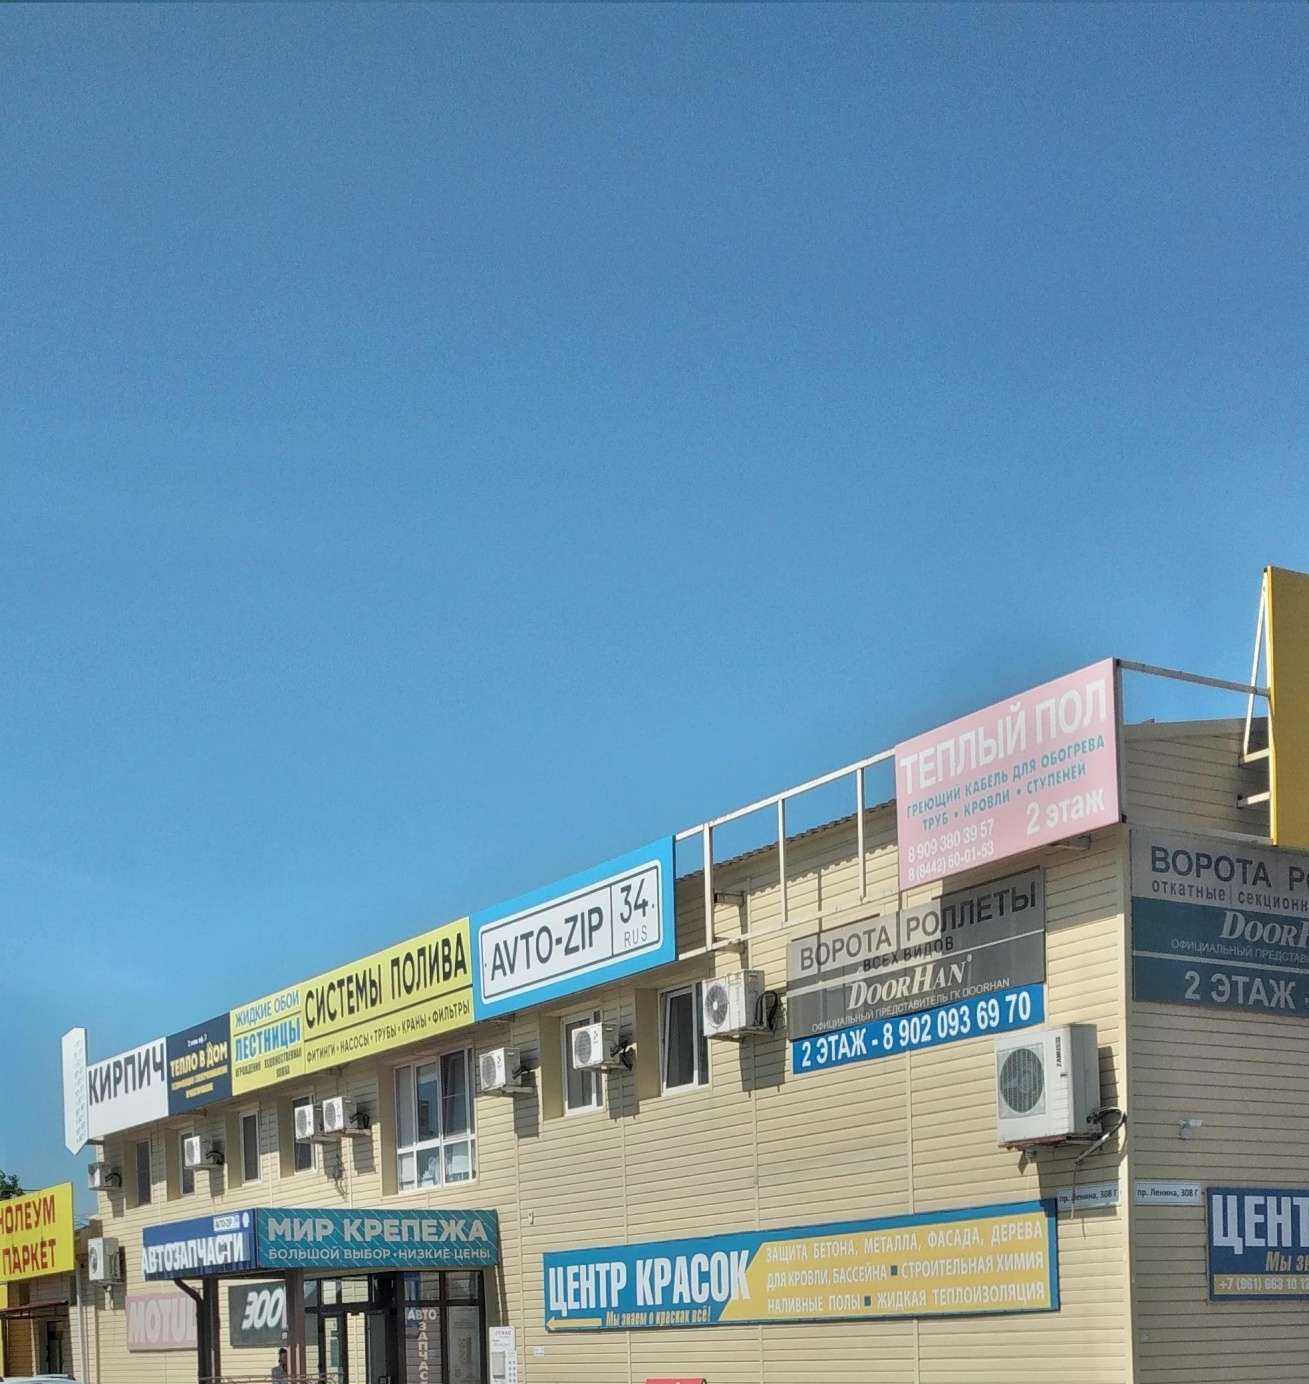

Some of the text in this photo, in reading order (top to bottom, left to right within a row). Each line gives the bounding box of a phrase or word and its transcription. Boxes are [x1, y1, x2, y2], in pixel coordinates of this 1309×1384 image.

[901, 679, 1108, 795] ТЕПЛЫЙ ПОЛ
[906, 734, 1105, 819] ГРЕЮЩИЙ КАБЕЛЬ ДЛЯ ОБОГРЕВА
[922, 764, 1087, 832] ТРУБ КРОВЛИ СТУПЕНЕЙ
[1026, 789, 1105, 836] 2 этаж
[907, 846, 915, 864] 8
[916, 838, 938, 860] 909
[963, 823, 978, 845] 39
[1151, 845, 1272, 889] ВОРОТА
[1151, 878, 1227, 902] откатные
[491, 878, 649, 982] AVTO-ZIP 34
[623, 924, 648, 948] RUS
[800, 880, 1037, 971] ВОРОТА РОЛЛЕТЫ
[862, 936, 955, 973] ВСЕХ ВИДОВ
[1171, 938, 1252, 960] ОФИЦИАЛЬНЫЙ
[305, 932, 467, 1029] СИСТЕМЫ ПОЛИВА
[1184, 970, 1297, 1010] 2 ЭТАЖ
[235, 990, 300, 1028] ЖИДКИЕ ОБОИ
[801, 1041, 811, 1068] 2
[816, 1027, 868, 1065] ЭТАЖ
[883, 1022, 894, 1051] 8
[899, 1014, 932, 1046] 902
[937, 1005, 972, 1039] 093
[976, 998, 1001, 1032] 69
[1005, 990, 1032, 1024] 70
[811, 1009, 876, 1033] ОФИЦИАЛЬНЫЙ
[876, 993, 949, 1018] ПРЕДСТАВИТЕЛЬ
[235, 1017, 301, 1061] ЛЕСТНИЦЫ
[306, 1000, 471, 1064] ФИТИНГИ НАСОСЫ ТРУБЫ КРАНЫ ФИЛЬТРЫ
[88, 1042, 165, 1106] КИРПИЧ
[170, 1052, 198, 1078] ТЕПЛО
[206, 1040, 228, 1068] ДОМ
[1137, 1189, 1149, 1198] пр.
[267, 1218, 334, 1242] МИР
[343, 1218, 489, 1242] КРЕПЕЖА
[766, 1221, 1042, 1265] ЗАЩИТА БЕТОНА, МЕТАЛЛА, ФАСАДА, ДЕРЕВА
[2, 1238, 57, 1275] ПАРКЕТ
[141, 1232, 244, 1274] АВТОЗАПЧАСТИ
[269, 1247, 490, 1261] БОЛЬШОЙ ВЫБОР НИЗКИЕ ЦЕНЫ
[766, 1272, 787, 1292] ДЛЯ
[832, 1263, 887, 1284] БАССЕЙНА
[902, 1256, 993, 1280] СТРОИТЕЛЬНАЯ
[996, 1250, 1044, 1273] ХИМИЯ
[1265, 1251, 1292, 1272] Мы
[549, 1250, 750, 1317] ЦЕНТР КРАСОК
[767, 1281, 1045, 1314] НАЛИВНЫЕ ПОЛЫ ЖИДКАЯ ТЕПЛОИЗОЛЯЦИЯ
[407, 1309, 437, 1321] АВТО
